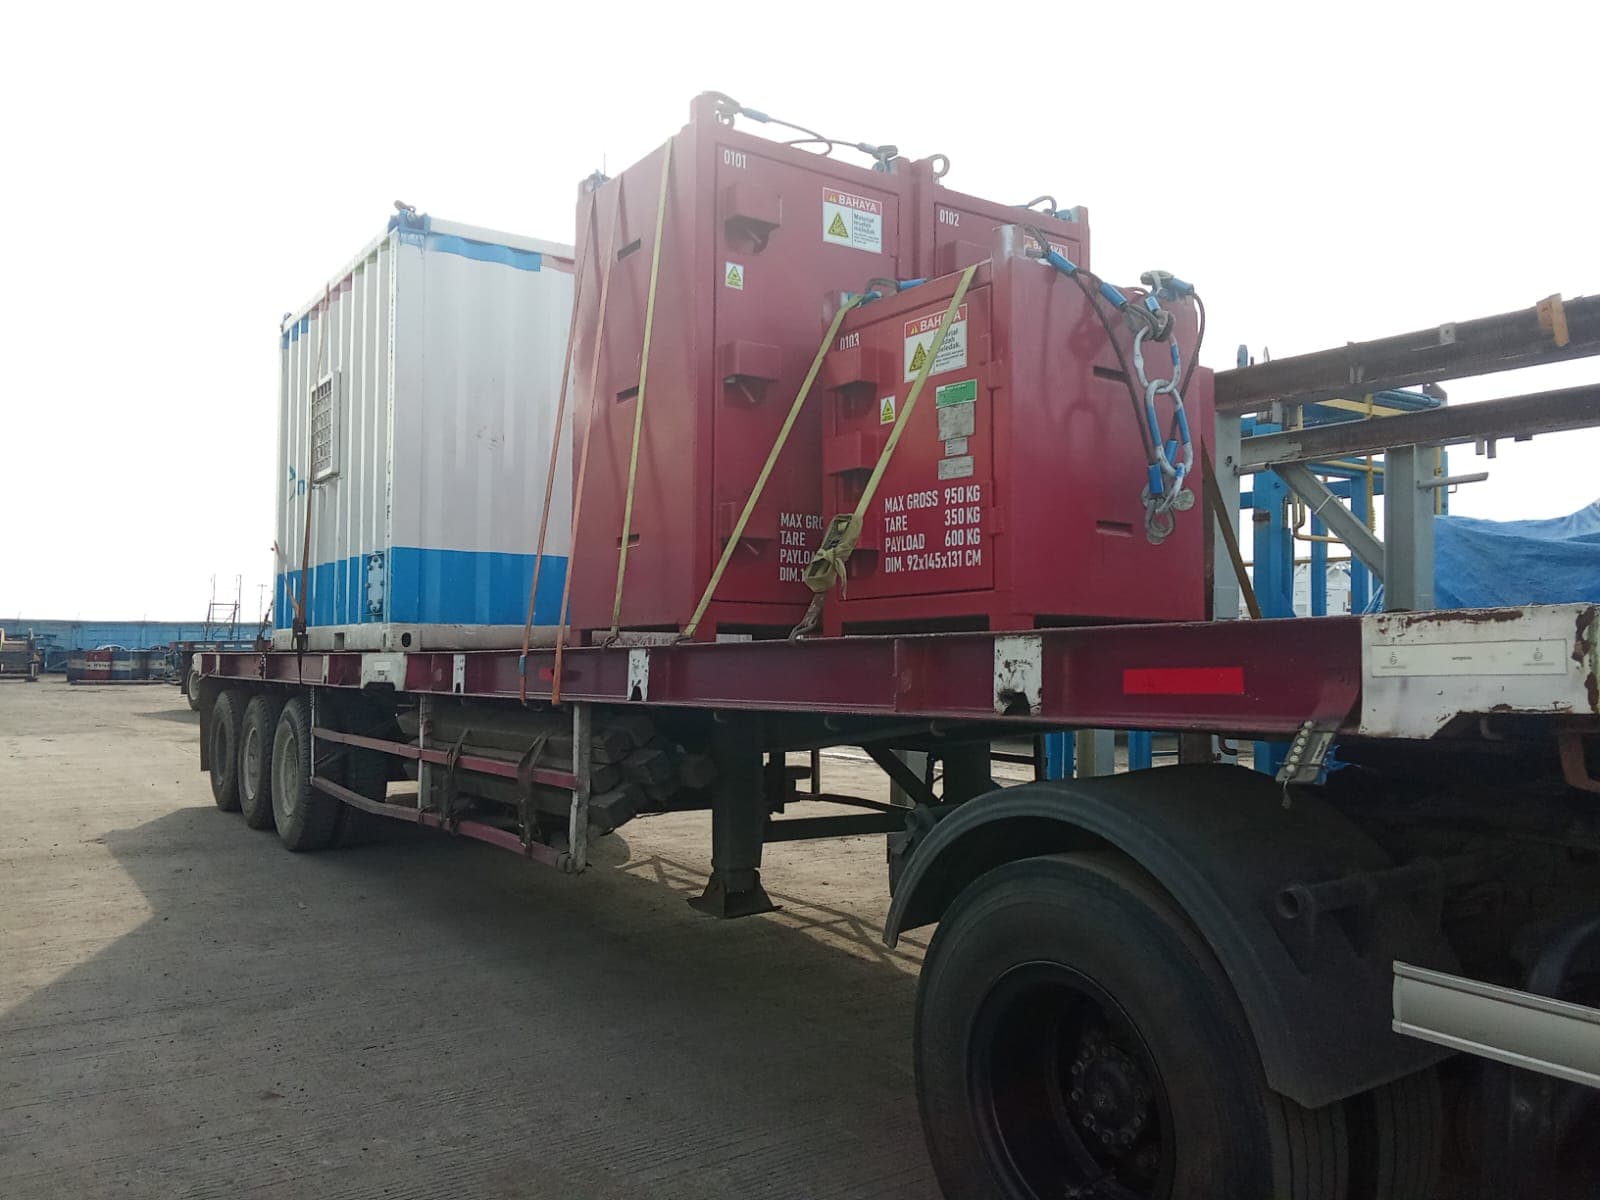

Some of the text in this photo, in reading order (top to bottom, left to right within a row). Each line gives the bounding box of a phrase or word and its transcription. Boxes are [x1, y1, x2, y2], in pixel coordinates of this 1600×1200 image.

[723, 149, 746, 169] 0101
[839, 194, 877, 212] BAHAYA
[939, 208, 960, 227] 0102
[920, 309, 962, 332] BAHA
[840, 332, 860, 352] 0103
[885, 485, 981, 514] MAX GROSS 950 KG
[780, 512, 803, 529] MAX
[885, 506, 981, 533] TARE 350 KG
[780, 530, 806, 547] TARE
[885, 527, 981, 554] PAYLOAD 600 KG
[885, 549, 982, 573] DIM. 92x145x131 CM
